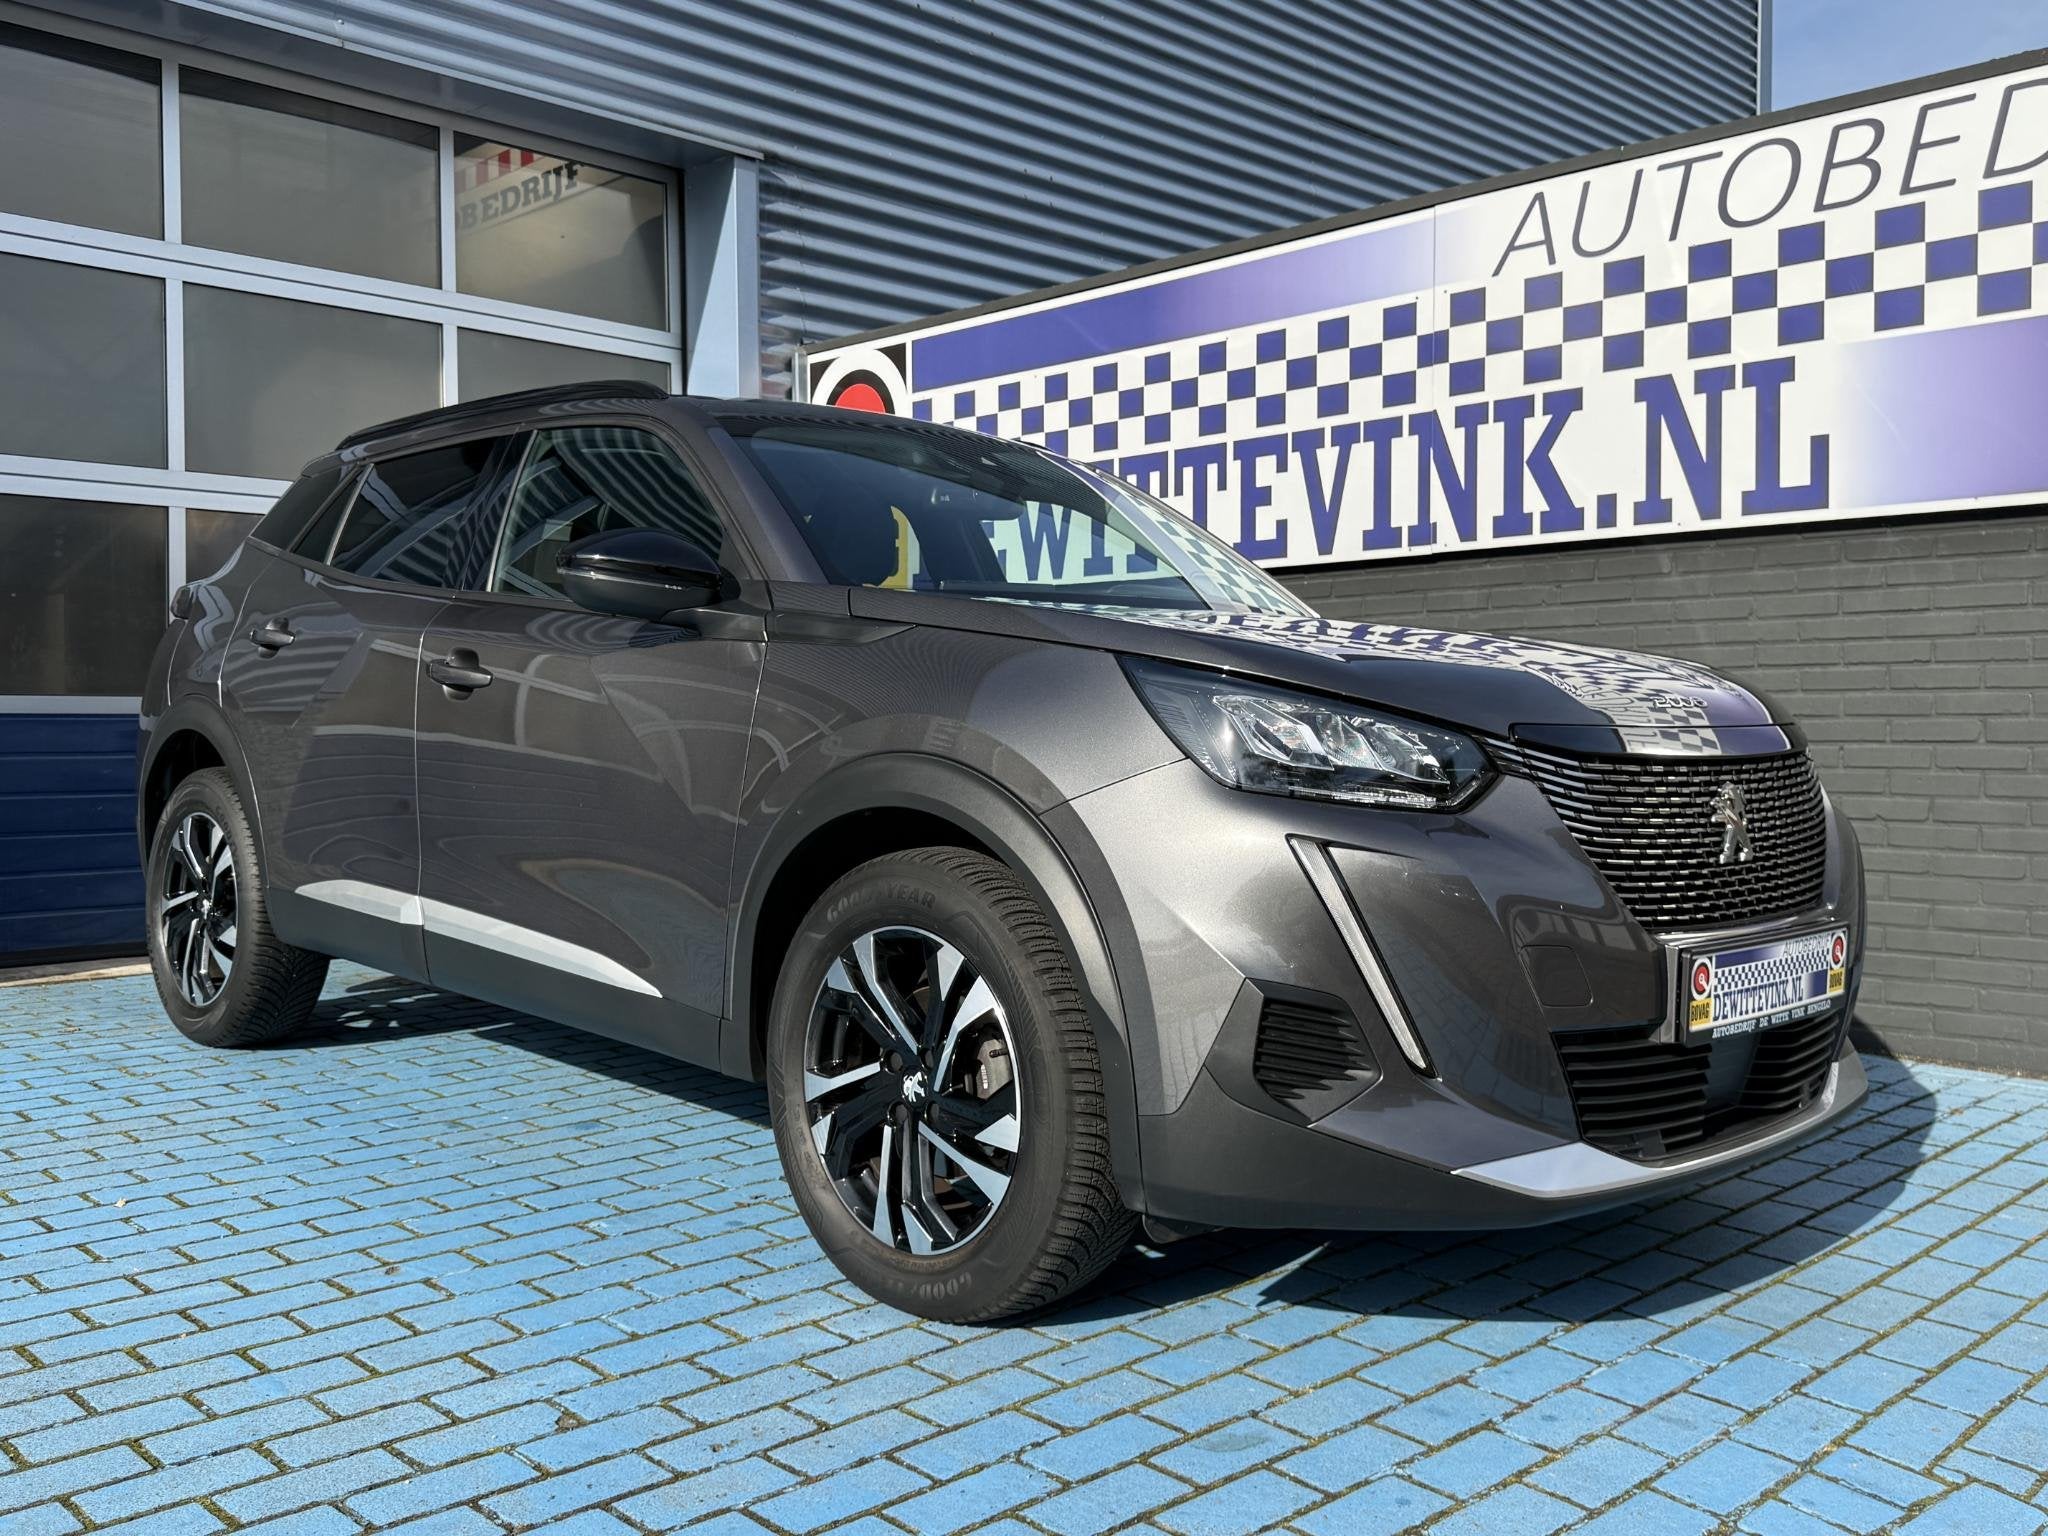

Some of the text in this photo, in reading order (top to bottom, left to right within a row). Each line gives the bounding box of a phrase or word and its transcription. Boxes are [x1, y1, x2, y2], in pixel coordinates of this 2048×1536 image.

[1491, 77, 2048, 277] AUTOBED
[912, 356, 1830, 591] WITTEVINK.NL
[1691, 1001, 1710, 1022] BOVAG
[1713, 975, 1803, 1021] DEWITTEVINK.NL
[1712, 1020, 1757, 1038] AUTOBEDRIJF
